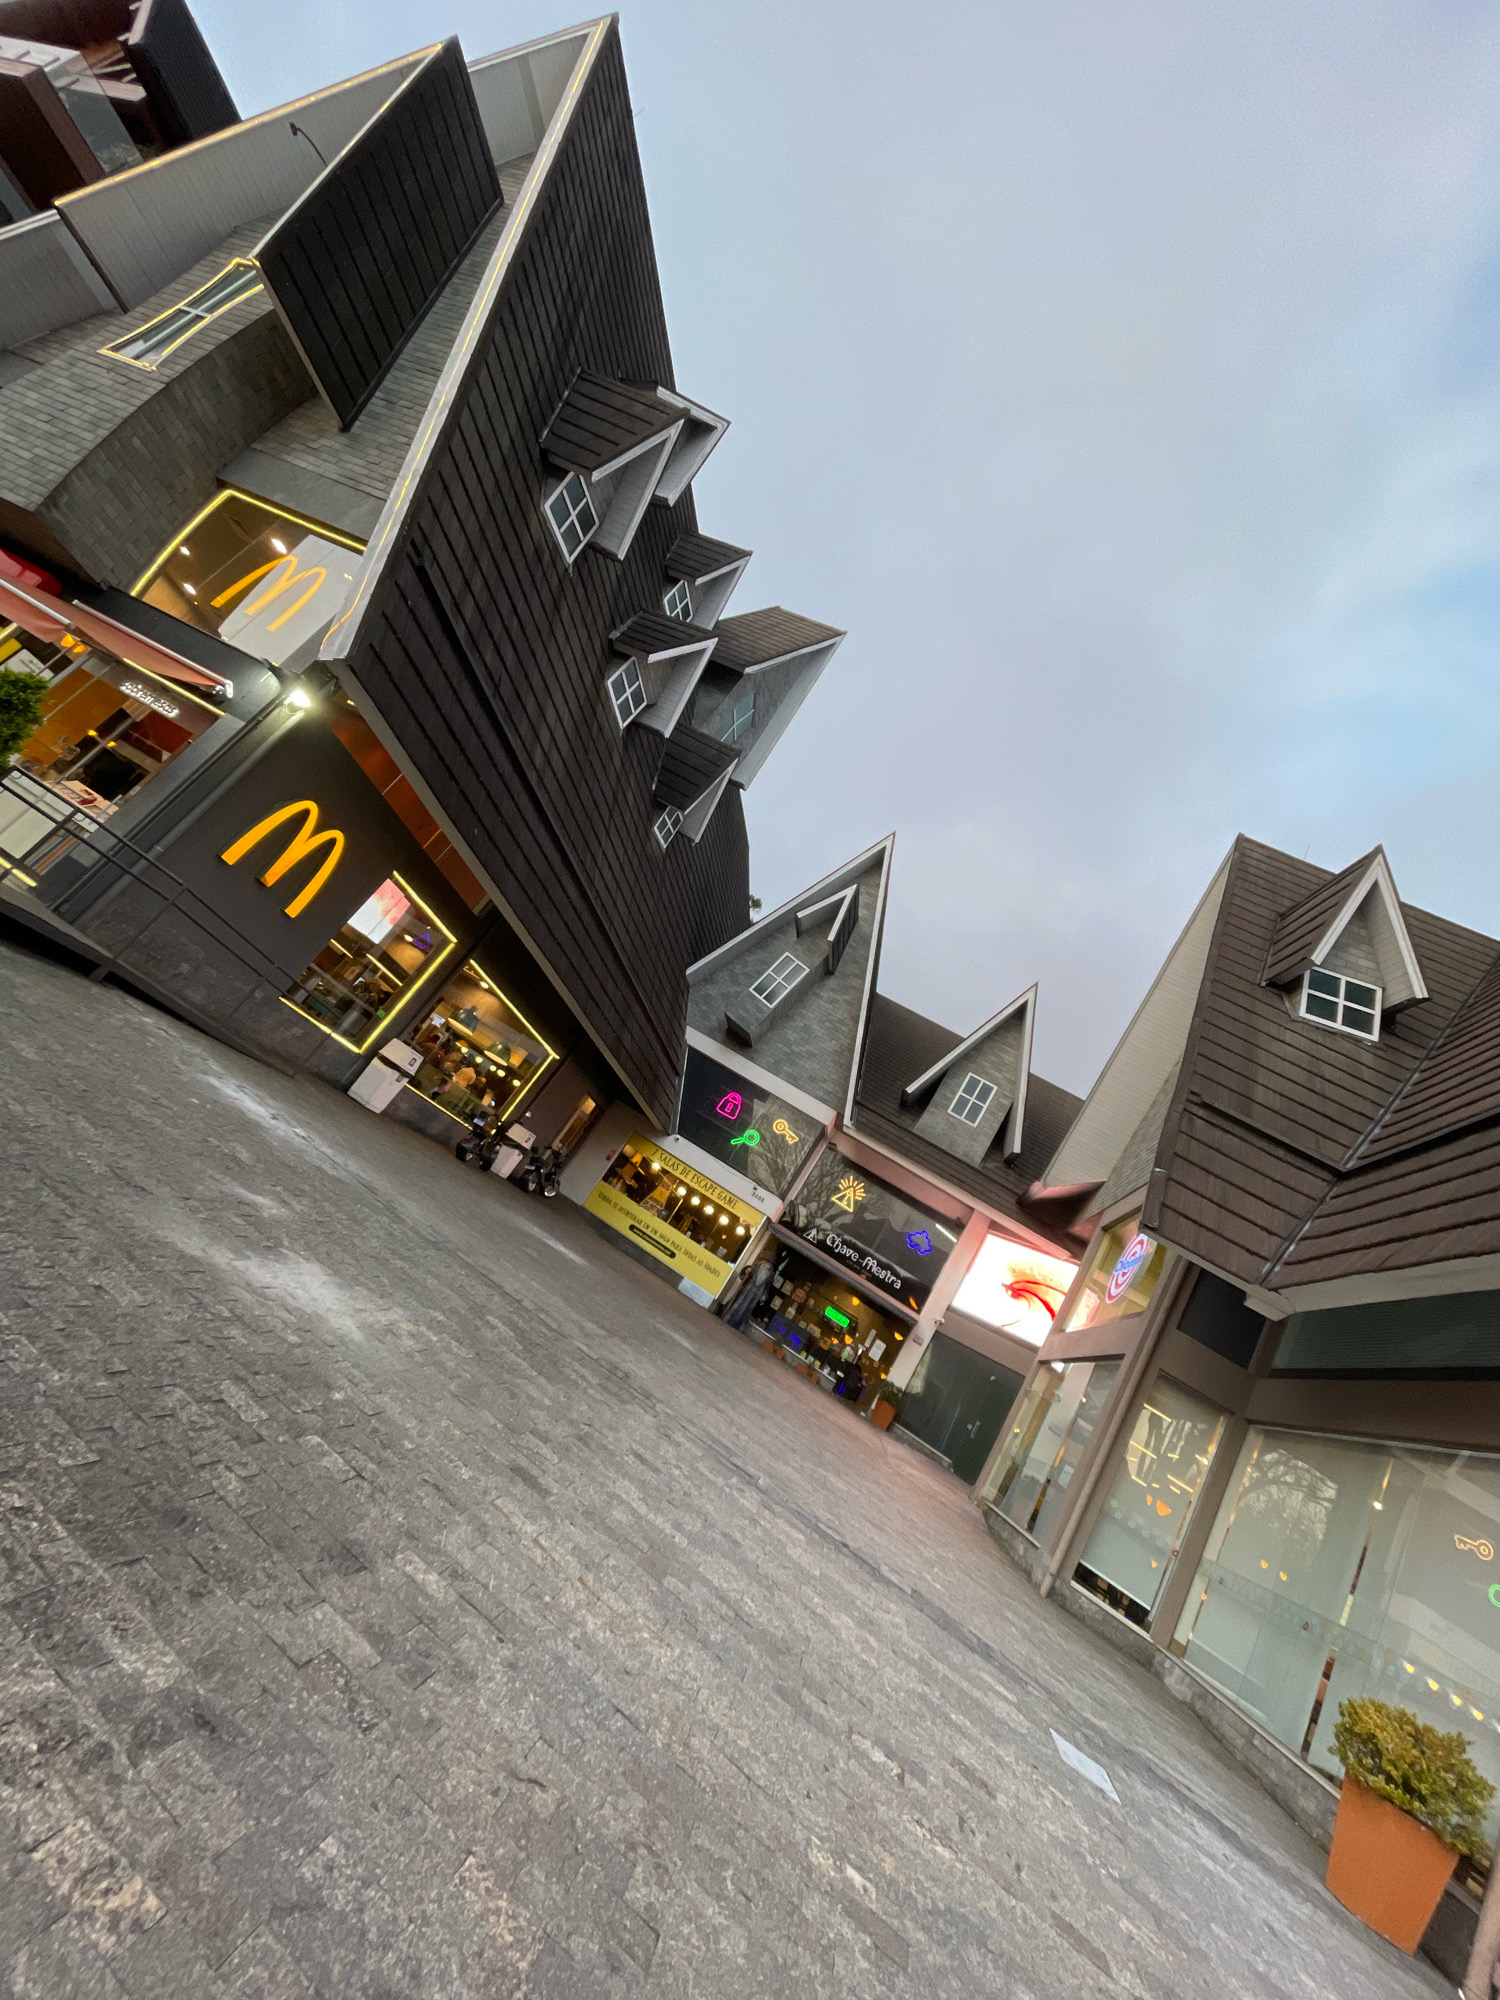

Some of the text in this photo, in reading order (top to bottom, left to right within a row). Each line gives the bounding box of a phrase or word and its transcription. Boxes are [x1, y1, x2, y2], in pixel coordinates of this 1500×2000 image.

[658, 1152, 680, 1171] SALAS
[679, 1166, 691, 1178] DE
[690, 1173, 717, 1195] ESCAPE
[717, 1190, 738, 1209] GAME
[826, 1234, 902, 1290] Chave-Mestra
